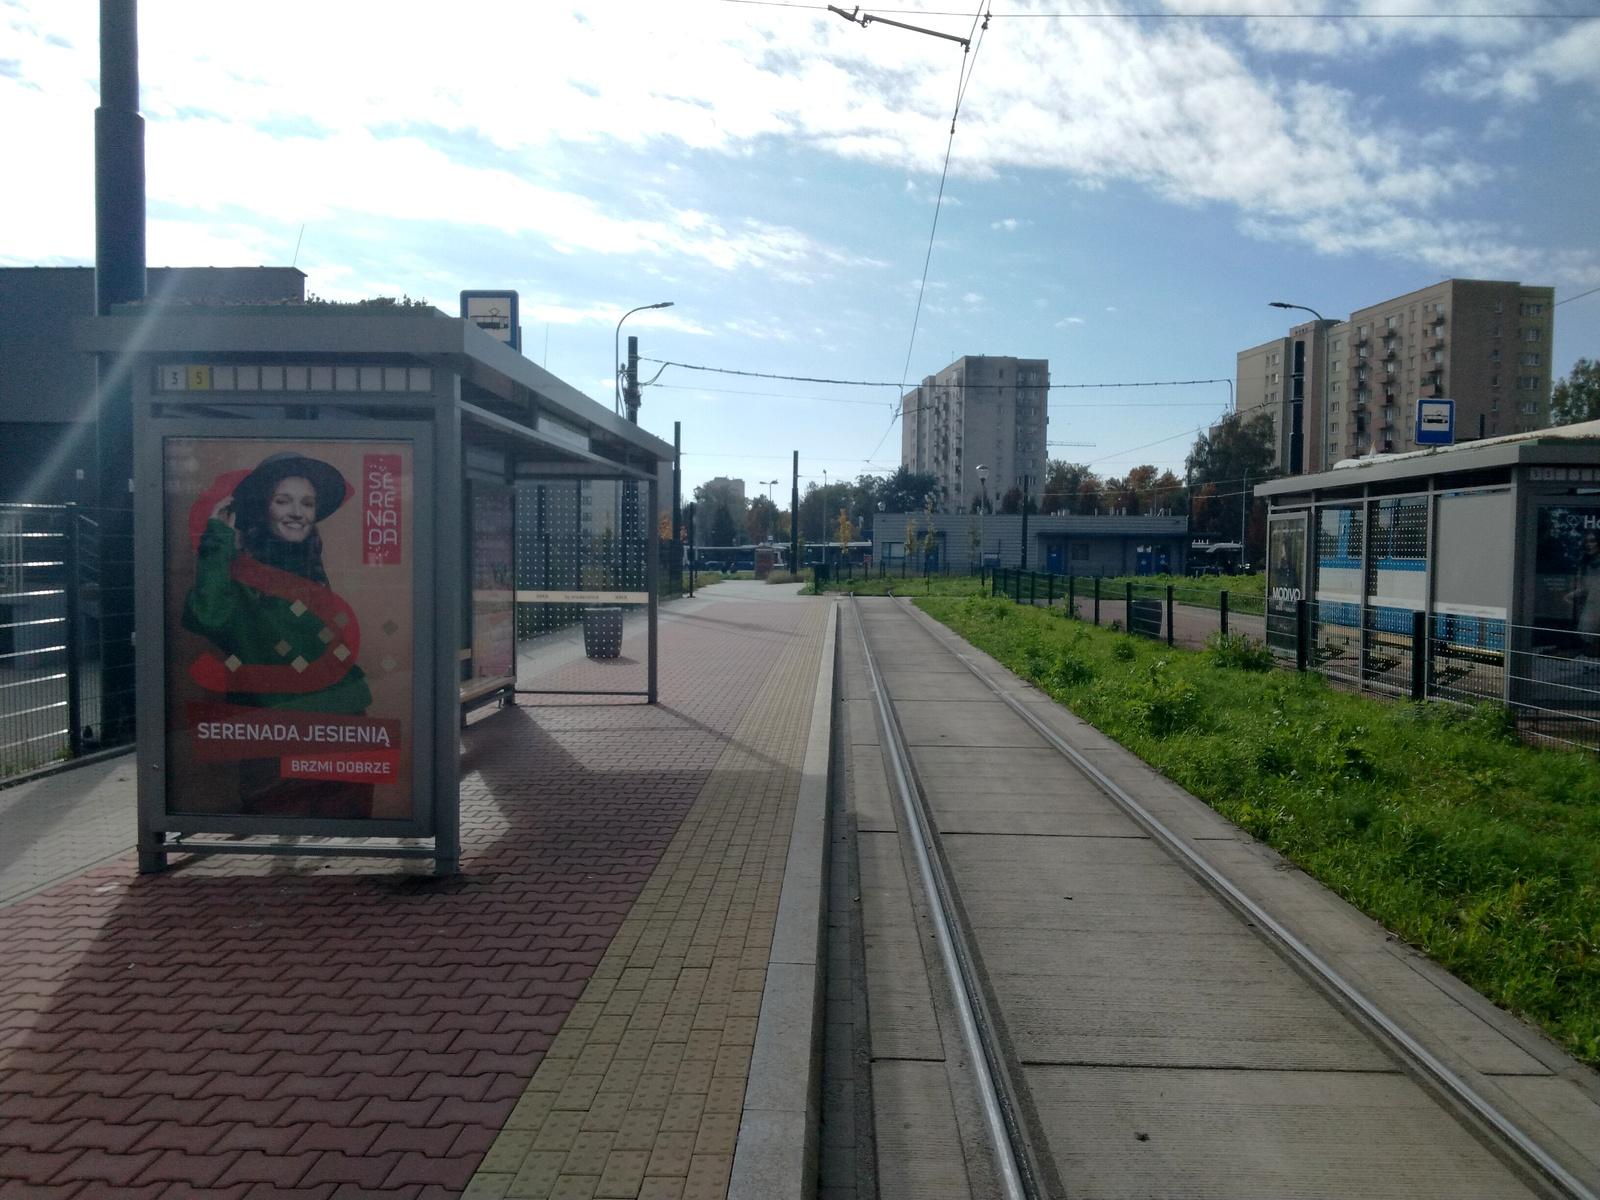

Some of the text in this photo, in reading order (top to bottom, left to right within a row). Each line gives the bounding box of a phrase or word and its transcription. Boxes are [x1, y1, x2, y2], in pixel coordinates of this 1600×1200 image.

[1272, 586, 1301, 602] MODIVO
[197, 722, 391, 748] SERENADA JESIENIĄ
[291, 759, 391, 774] BRZMI DOBRZE
